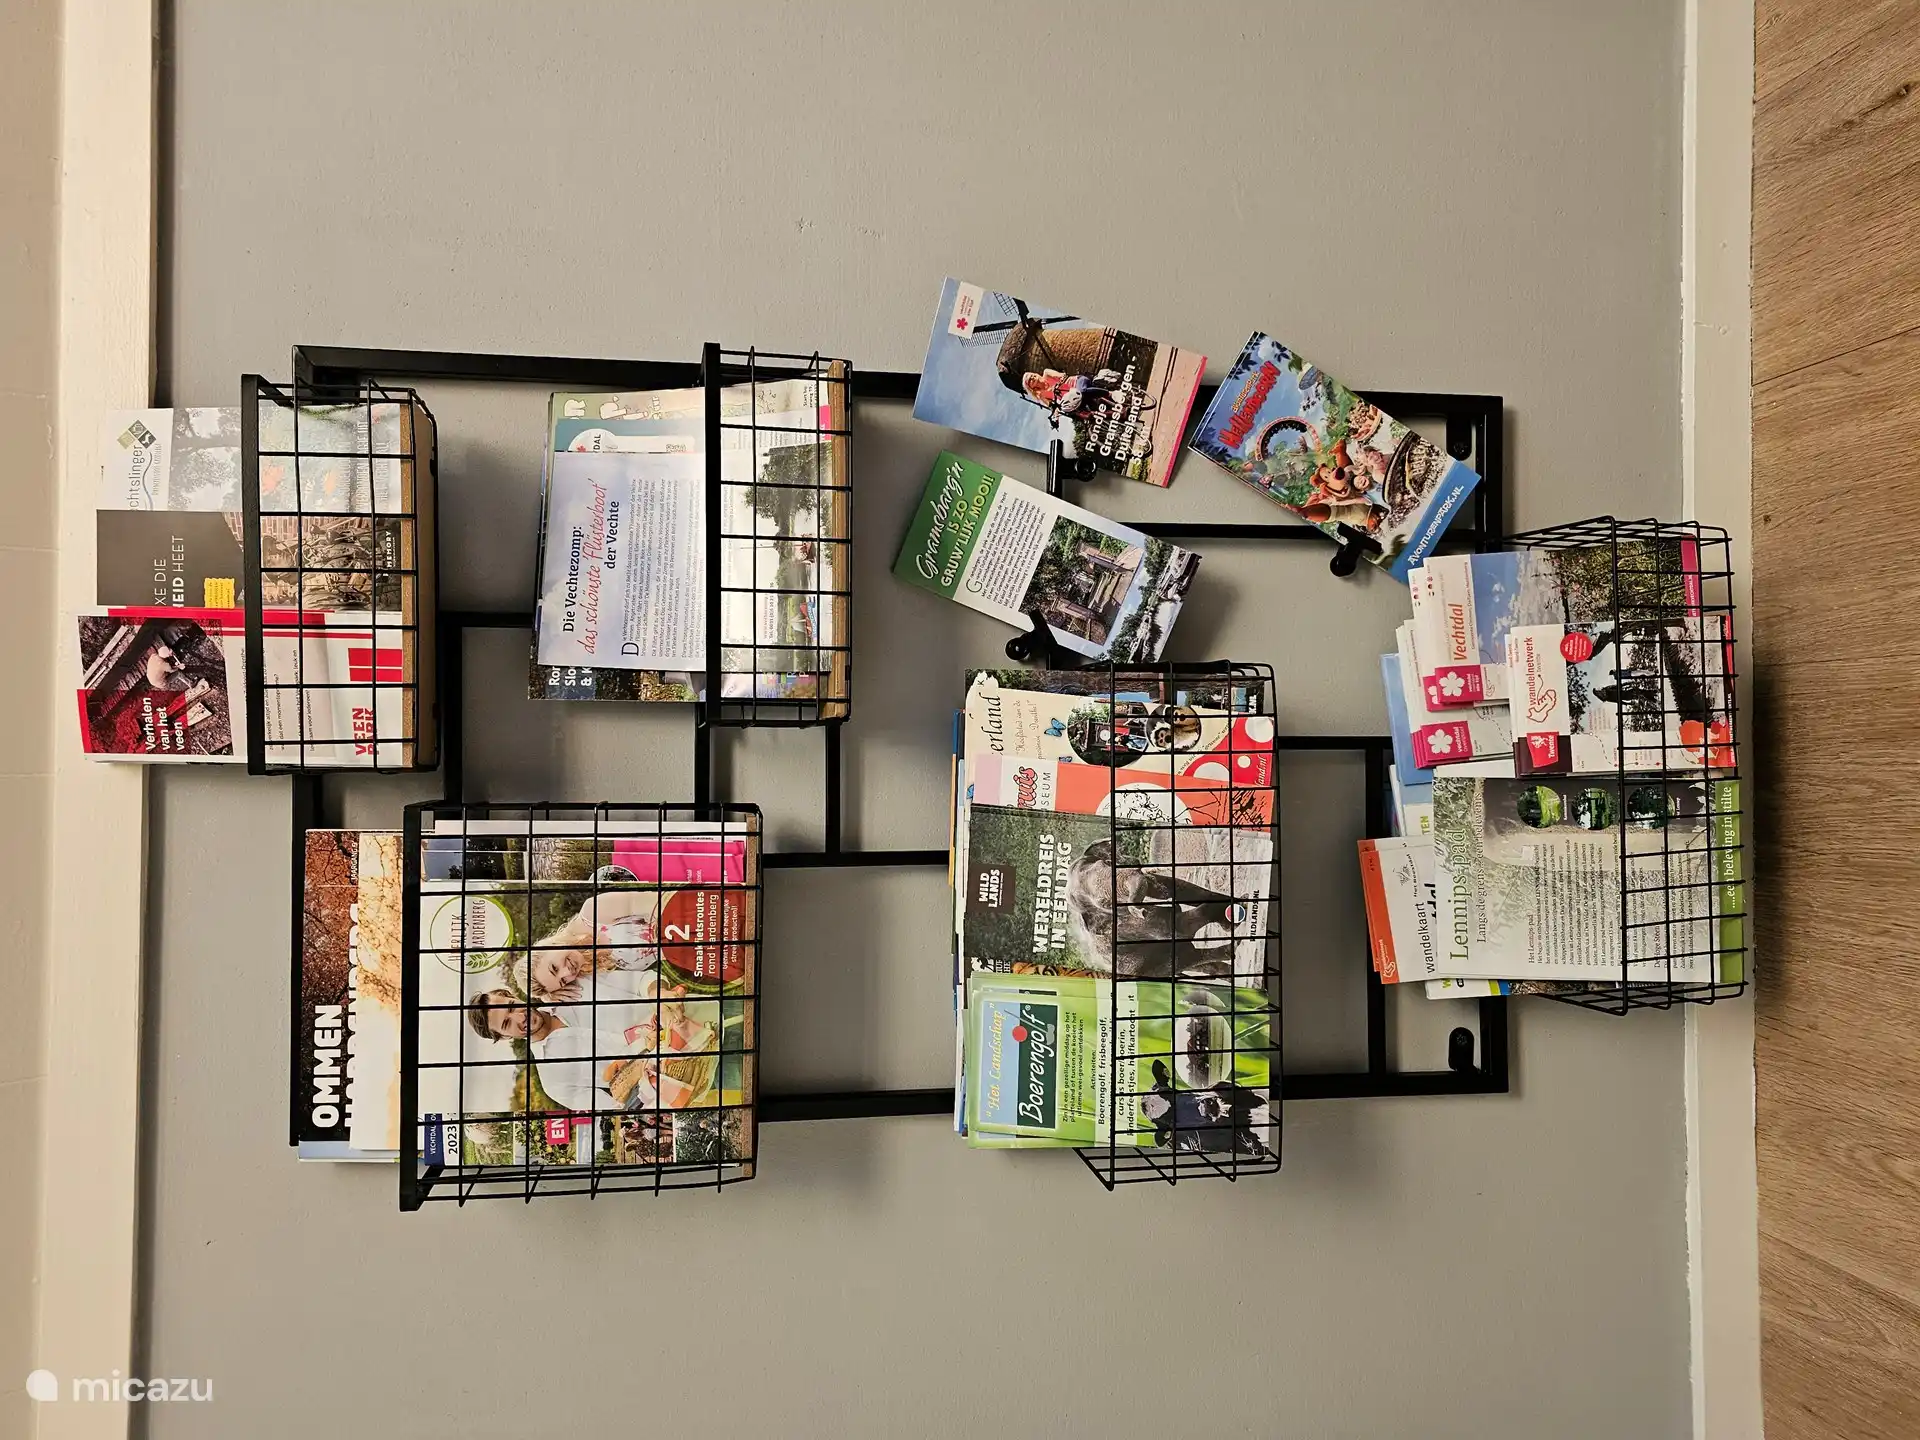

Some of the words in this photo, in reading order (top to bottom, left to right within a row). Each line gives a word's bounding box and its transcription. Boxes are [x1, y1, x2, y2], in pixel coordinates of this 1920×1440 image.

[1085, 403, 1107, 452] Rondje
[1100, 364, 1135, 456] Gramsbergen
[1114, 396, 1142, 460] Duitsland
[605, 501, 619, 545] Vechte
[916, 462, 964, 579] Gramsbarg'n
[946, 521, 960, 534] IS
[952, 500, 968, 520] ZO
[1408, 485, 1464, 565] AVONTURENPARK.NL
[941, 519, 976, 586] GRUW'LIJK
[969, 474, 994, 519] MOOI!
[154, 559, 166, 582] DIE
[171, 535, 184, 572] HEET
[564, 526, 583, 608] Vechtezomp:
[604, 547, 617, 569] der
[580, 565, 600, 624] schönste
[563, 611, 576, 632] Die
[1448, 603, 1468, 660] Vechtdal
[577, 628, 598, 655] das
[565, 666, 576, 686] Slo
[581, 677, 592, 686] &
[1524, 637, 1536, 705] wandelnetwerk
[142, 698, 156, 750] Verhalen
[156, 707, 168, 726] het
[352, 708, 366, 755] VEEN
[979, 692, 1004, 755] erland
[160, 730, 170, 750] van
[174, 722, 184, 750] veen
[1453, 726, 1462, 752] vechtdal
[1040, 772, 1051, 810] SEUM
[1721, 786, 1732, 813] stilte
[1420, 816, 1430, 835] TEN
[1722, 816, 1732, 828] in
[1055, 842, 1072, 880] DAG
[1476, 841, 1484, 858] een
[1723, 830, 1736, 875] beleving
[979, 872, 990, 902] WILD
[988, 869, 1000, 908] LANDS
[1033, 834, 1054, 953] WERELDREIS
[1050, 886, 1068, 923] ÉÉN
[1446, 828, 1473, 960] Lennips-pad
[1475, 898, 1486, 910] de
[664, 924, 690, 940] 2
[1051, 928, 1066, 949] IN
[1415, 902, 1435, 973] wandelkaart
[1476, 912, 1488, 943] Langs
[707, 953, 716, 974] rond
[1065, 1024, 1071, 1032] op
[1099, 1017, 1107, 1069] frisbeegolf,
[312, 1004, 342, 1128] OMMEN
[1071, 1048, 1076, 1056] de
[1098, 1072, 1106, 1125] Boerengolf,
[448, 1126, 457, 1154] 2023
